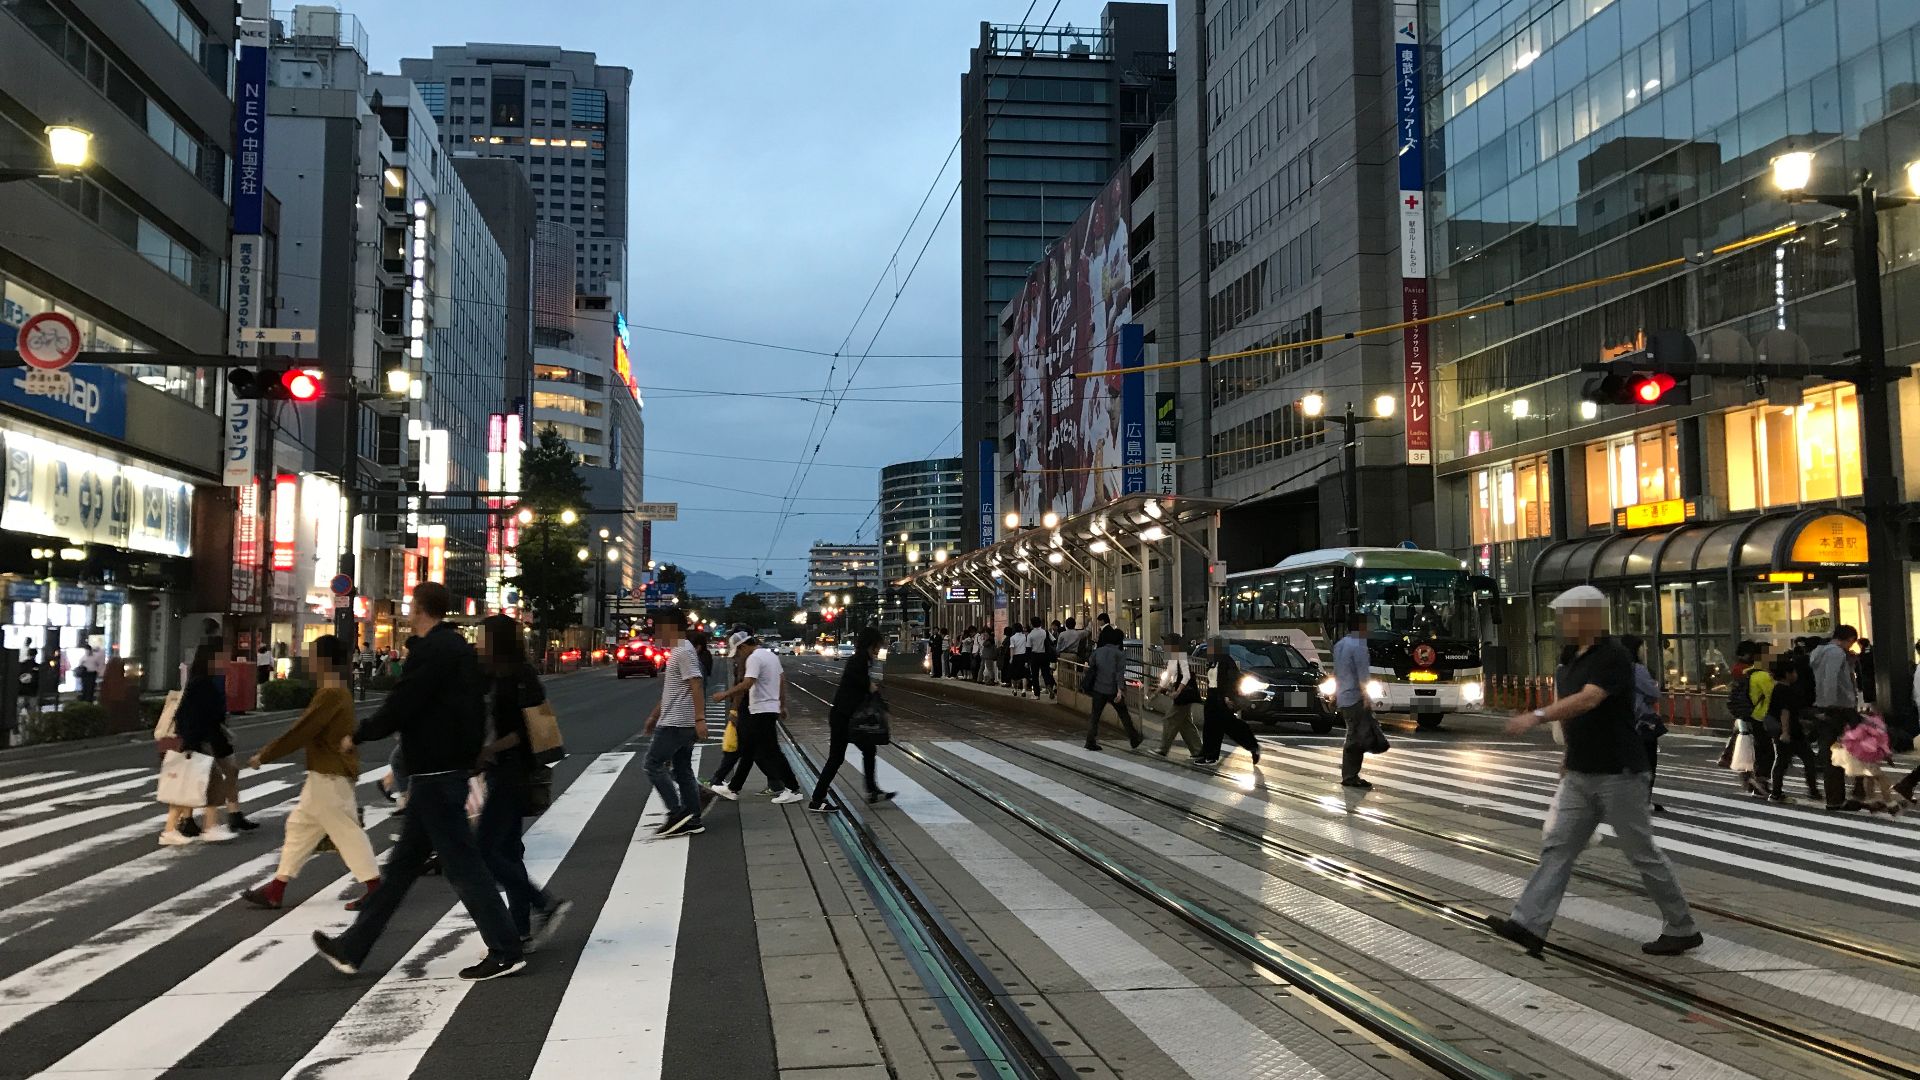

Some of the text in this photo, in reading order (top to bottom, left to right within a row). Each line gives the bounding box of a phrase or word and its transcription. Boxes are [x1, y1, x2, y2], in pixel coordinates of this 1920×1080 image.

[241, 30, 266, 39] NEC
[240, 83, 260, 195] NEC中国支社
[228, 403, 249, 461] フマップ
[1126, 422, 1144, 492] 広島銀行
[1413, 453, 1425, 461] 3F
[982, 502, 993, 548] 広島銀行
[1819, 536, 1858, 549] 本通駅
